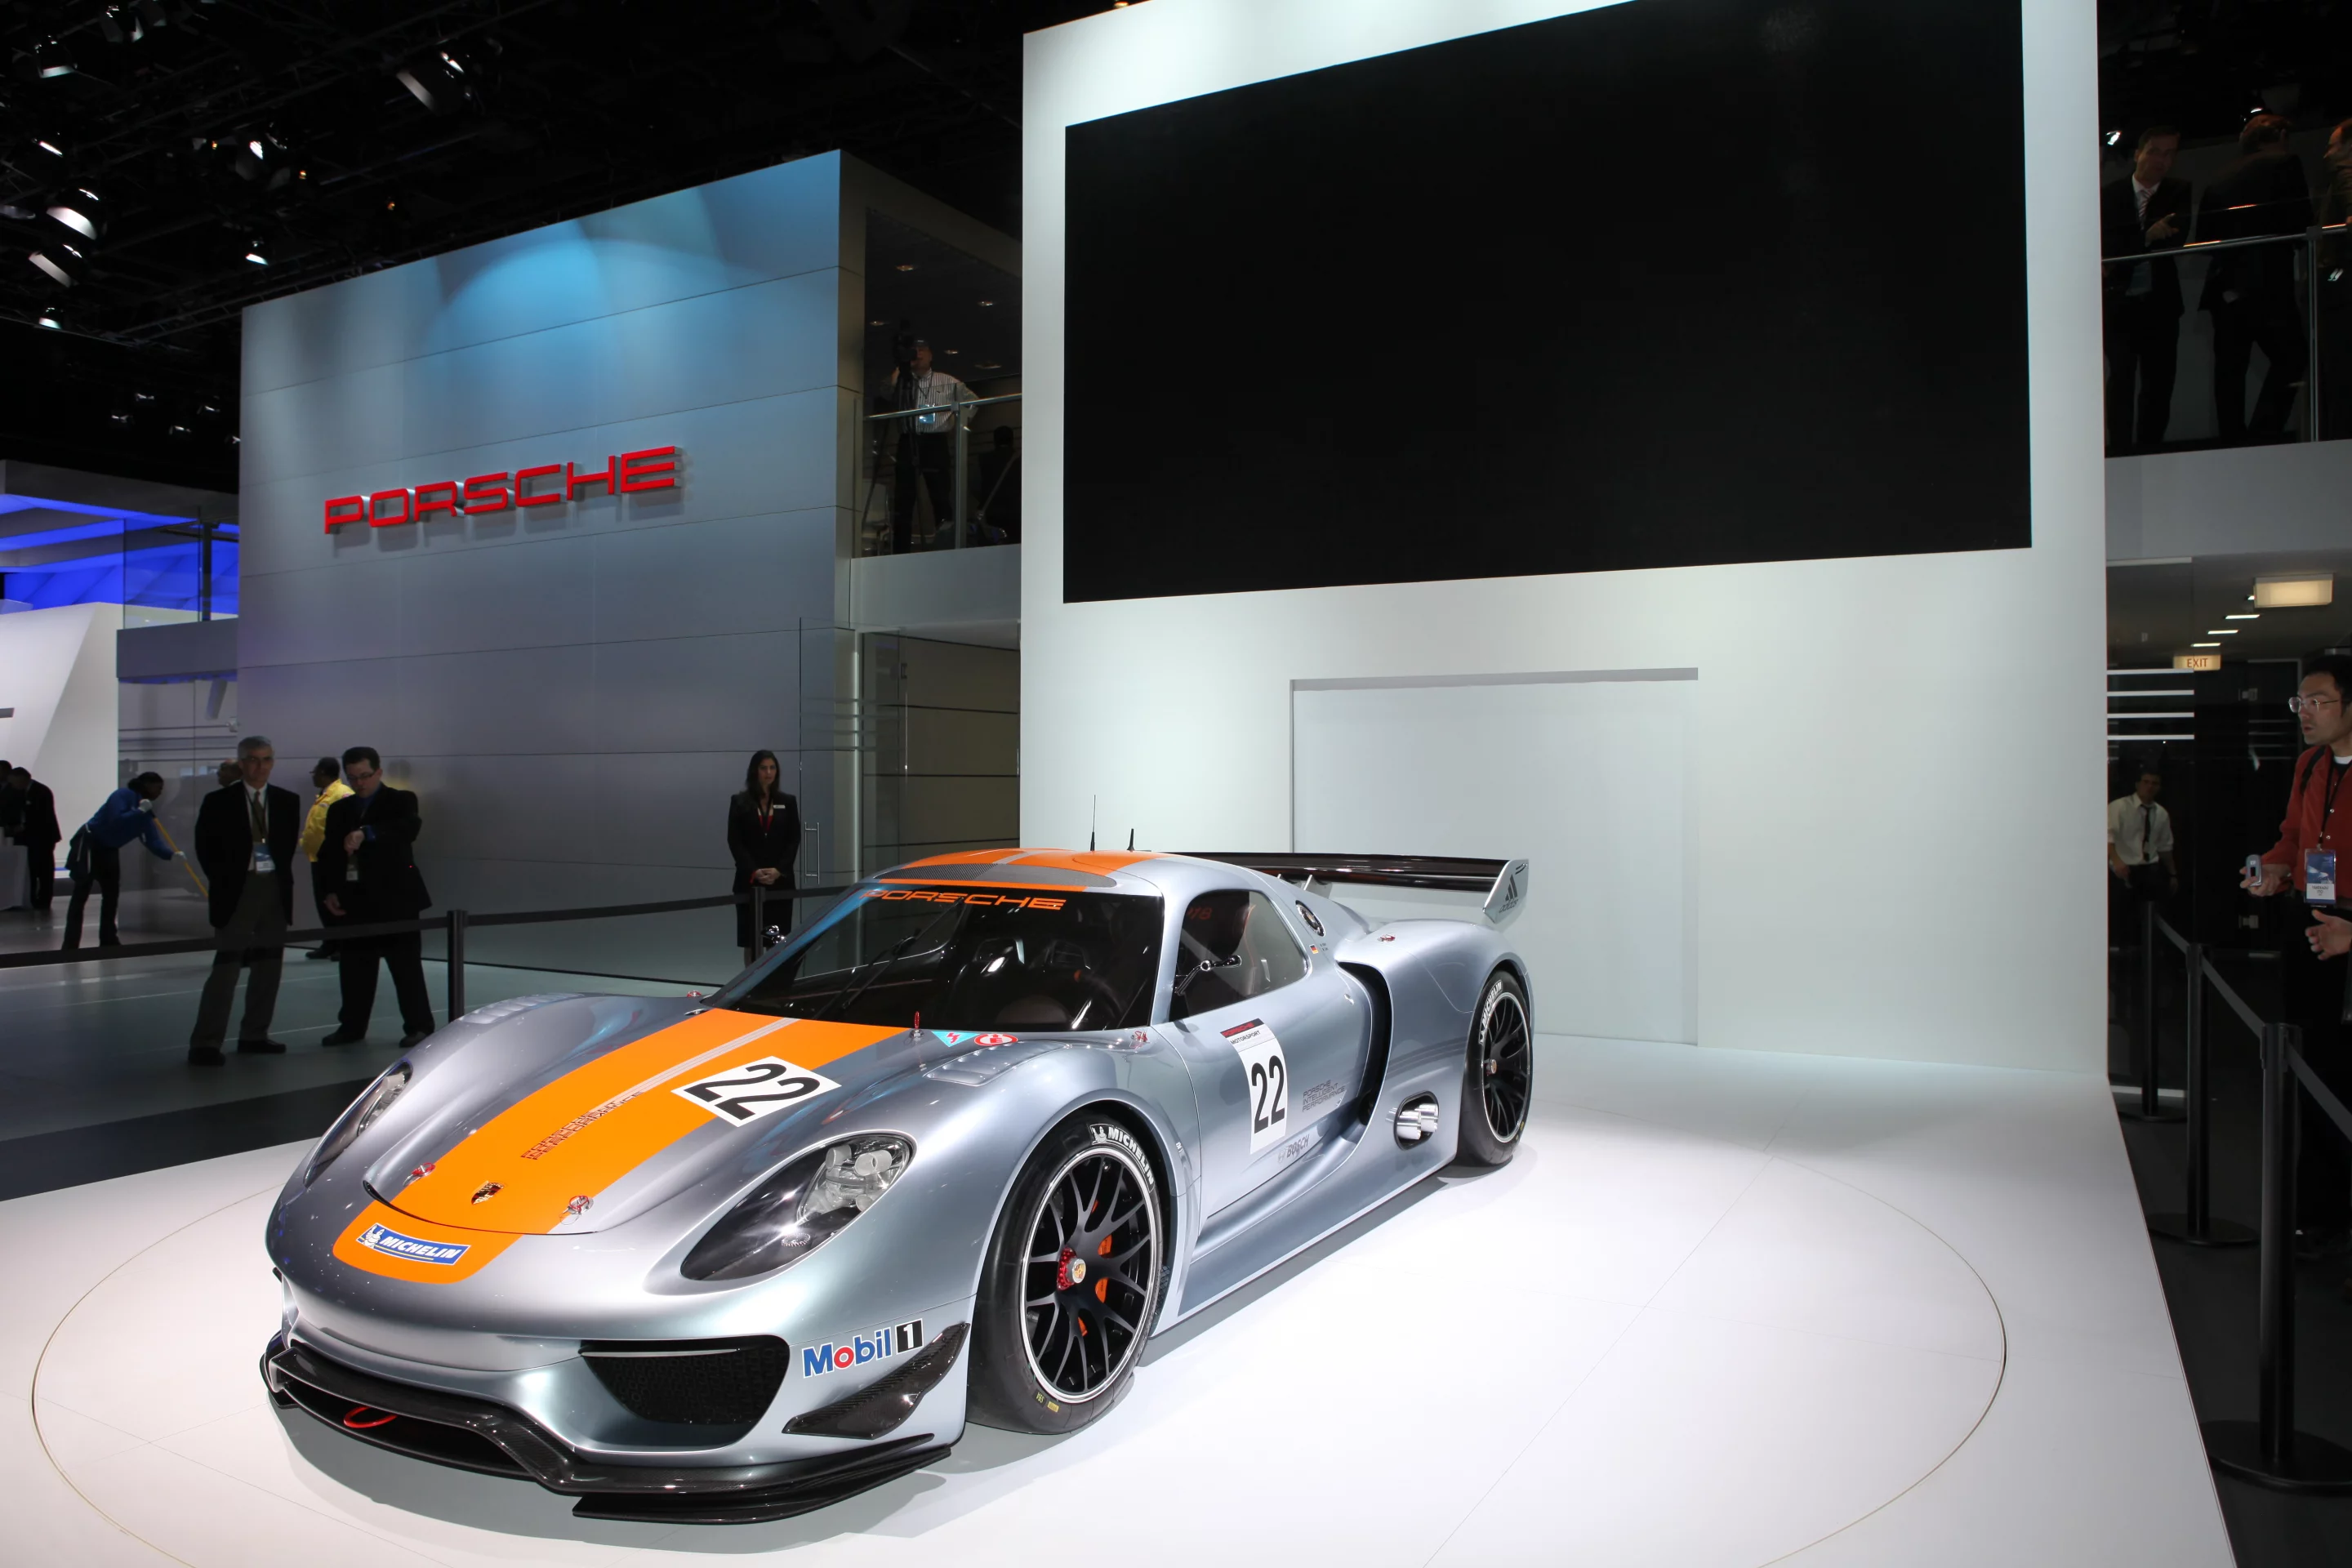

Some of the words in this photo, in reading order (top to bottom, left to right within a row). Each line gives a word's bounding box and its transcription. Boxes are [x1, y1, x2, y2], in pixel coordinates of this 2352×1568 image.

[324, 446, 675, 534] PORSCHE
[2187, 657, 2208, 668] EXIT
[859, 889, 1067, 911] PORSCHE
[1481, 981, 1502, 1030] MICHELIN
[1230, 1030, 1261, 1045] MOTORSPORT
[683, 1062, 821, 1121] 22
[1251, 1055, 1285, 1134] 22
[1303, 1079, 1330, 1098] PORSCHE
[1303, 1082, 1339, 1105] INTELLIGENT
[1303, 1085, 1346, 1111] PERFORMANCE
[1108, 1126, 1155, 1185] MICHELIN
[1287, 1134, 1310, 1158] BOSCH
[380, 1236, 461, 1258] MICHELIN
[803, 1327, 893, 1379] Mobil
